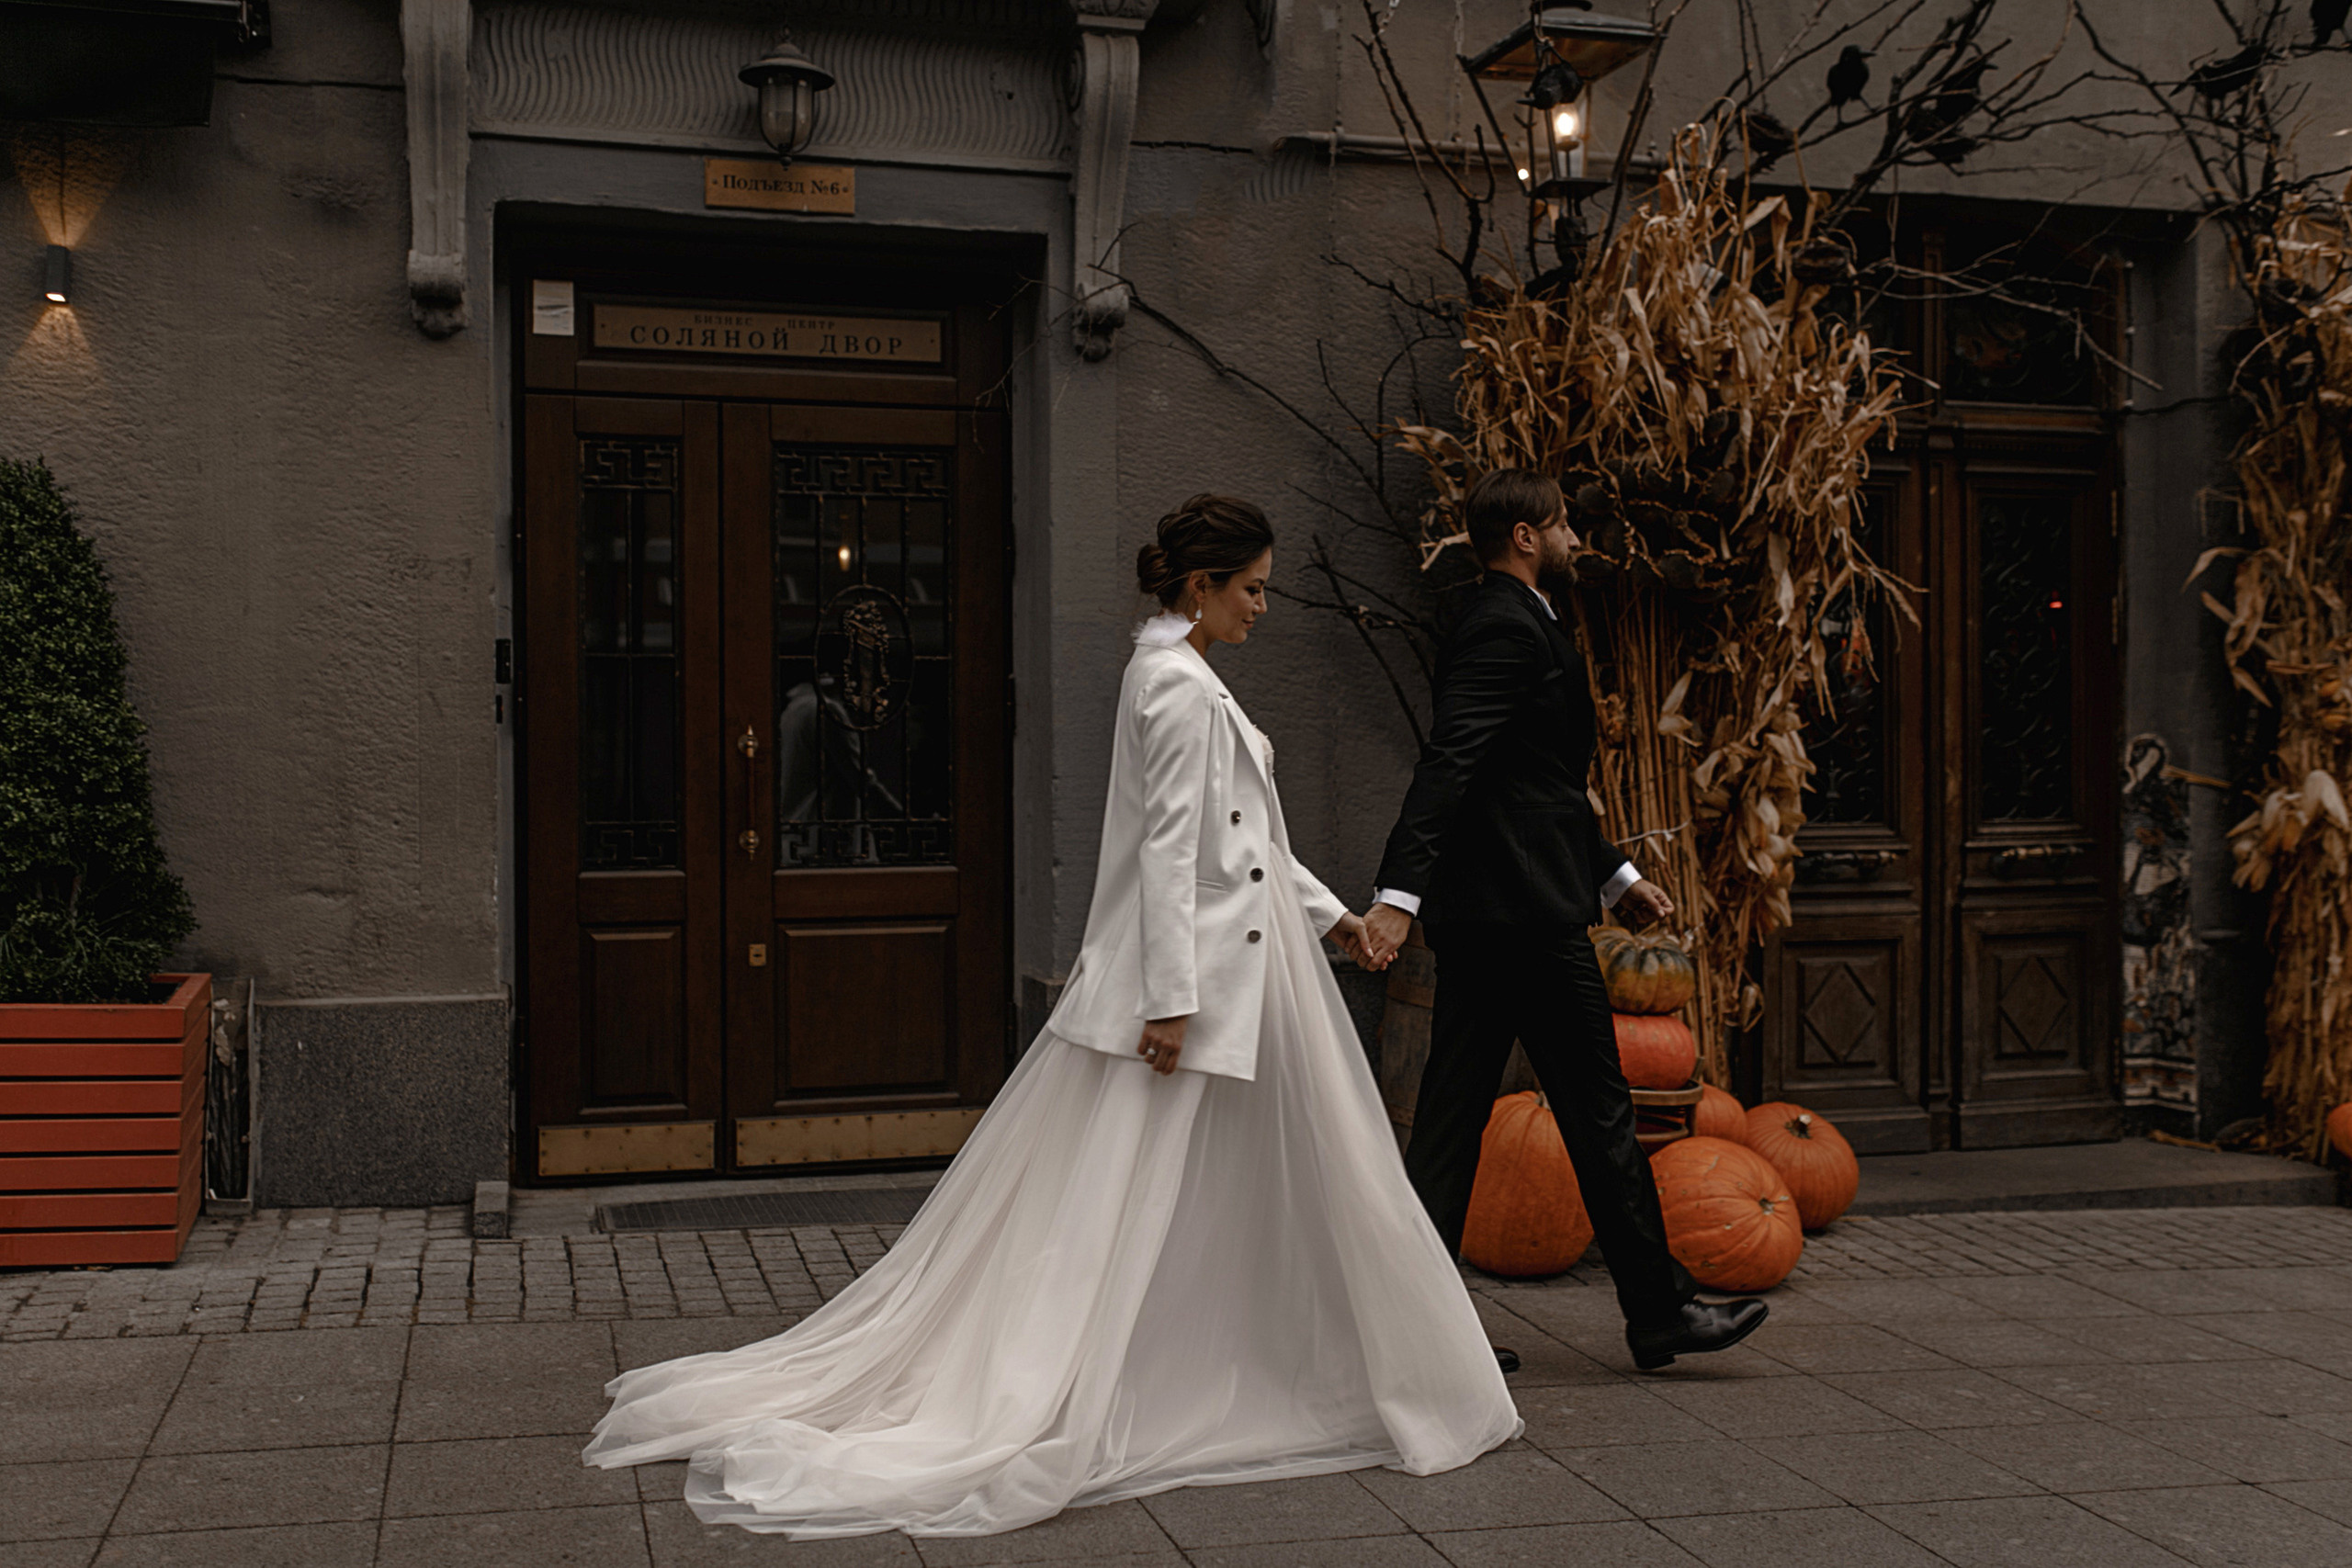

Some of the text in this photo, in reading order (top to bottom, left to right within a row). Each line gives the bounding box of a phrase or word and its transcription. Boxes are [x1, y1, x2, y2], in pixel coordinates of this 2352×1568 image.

[694, 314, 835, 330] БИЗНЕС ЦЕНТР
[629, 325, 902, 355] СОЛЯНОЙ ДВОР
